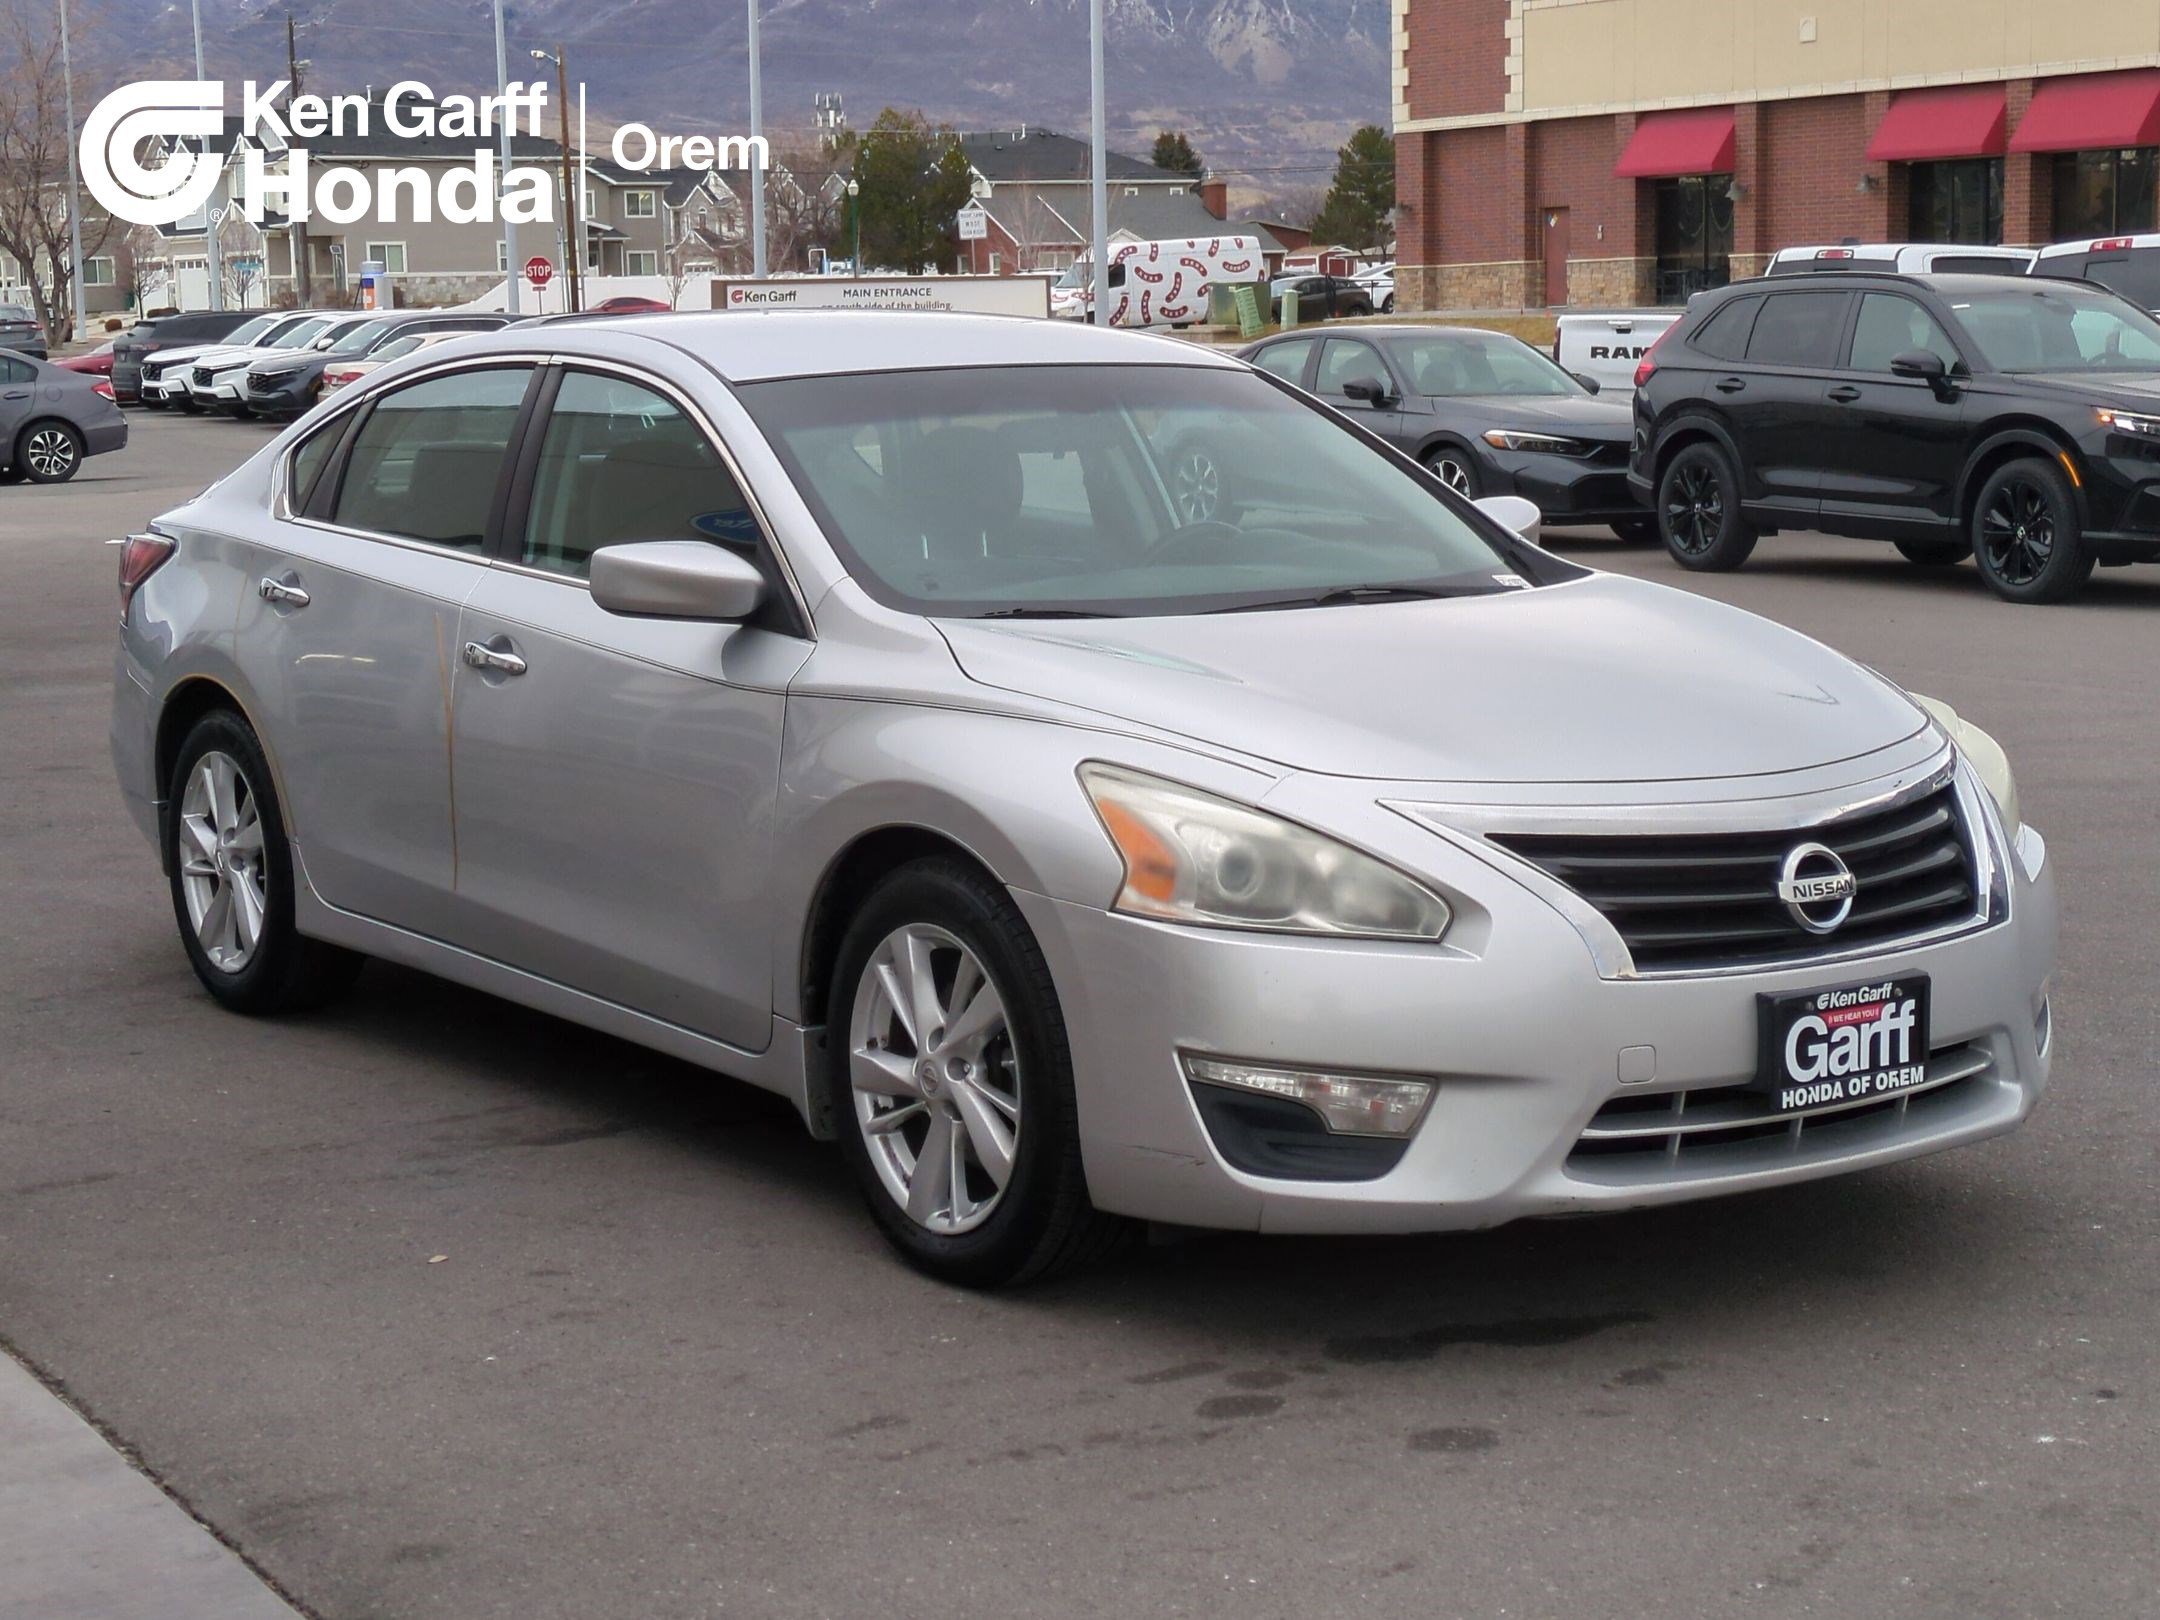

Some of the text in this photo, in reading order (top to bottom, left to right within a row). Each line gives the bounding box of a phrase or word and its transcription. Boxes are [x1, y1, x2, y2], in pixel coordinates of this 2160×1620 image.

[527, 265, 551, 277] STOP
[744, 290, 797, 303] Ken Garff
[843, 287, 932, 298] MAIN ENTRANCE
[885, 301, 894, 310] of
[896, 301, 912, 310] the
[1792, 879, 1853, 899] NISSAN
[1830, 982, 1893, 1009] Ken Garff
[1833, 1013, 1844, 1023] WE
[1862, 1008, 1875, 1019] YOU
[1785, 999, 1916, 1083] Garff
[1782, 1065, 1924, 1109] HONDA OF OREM
